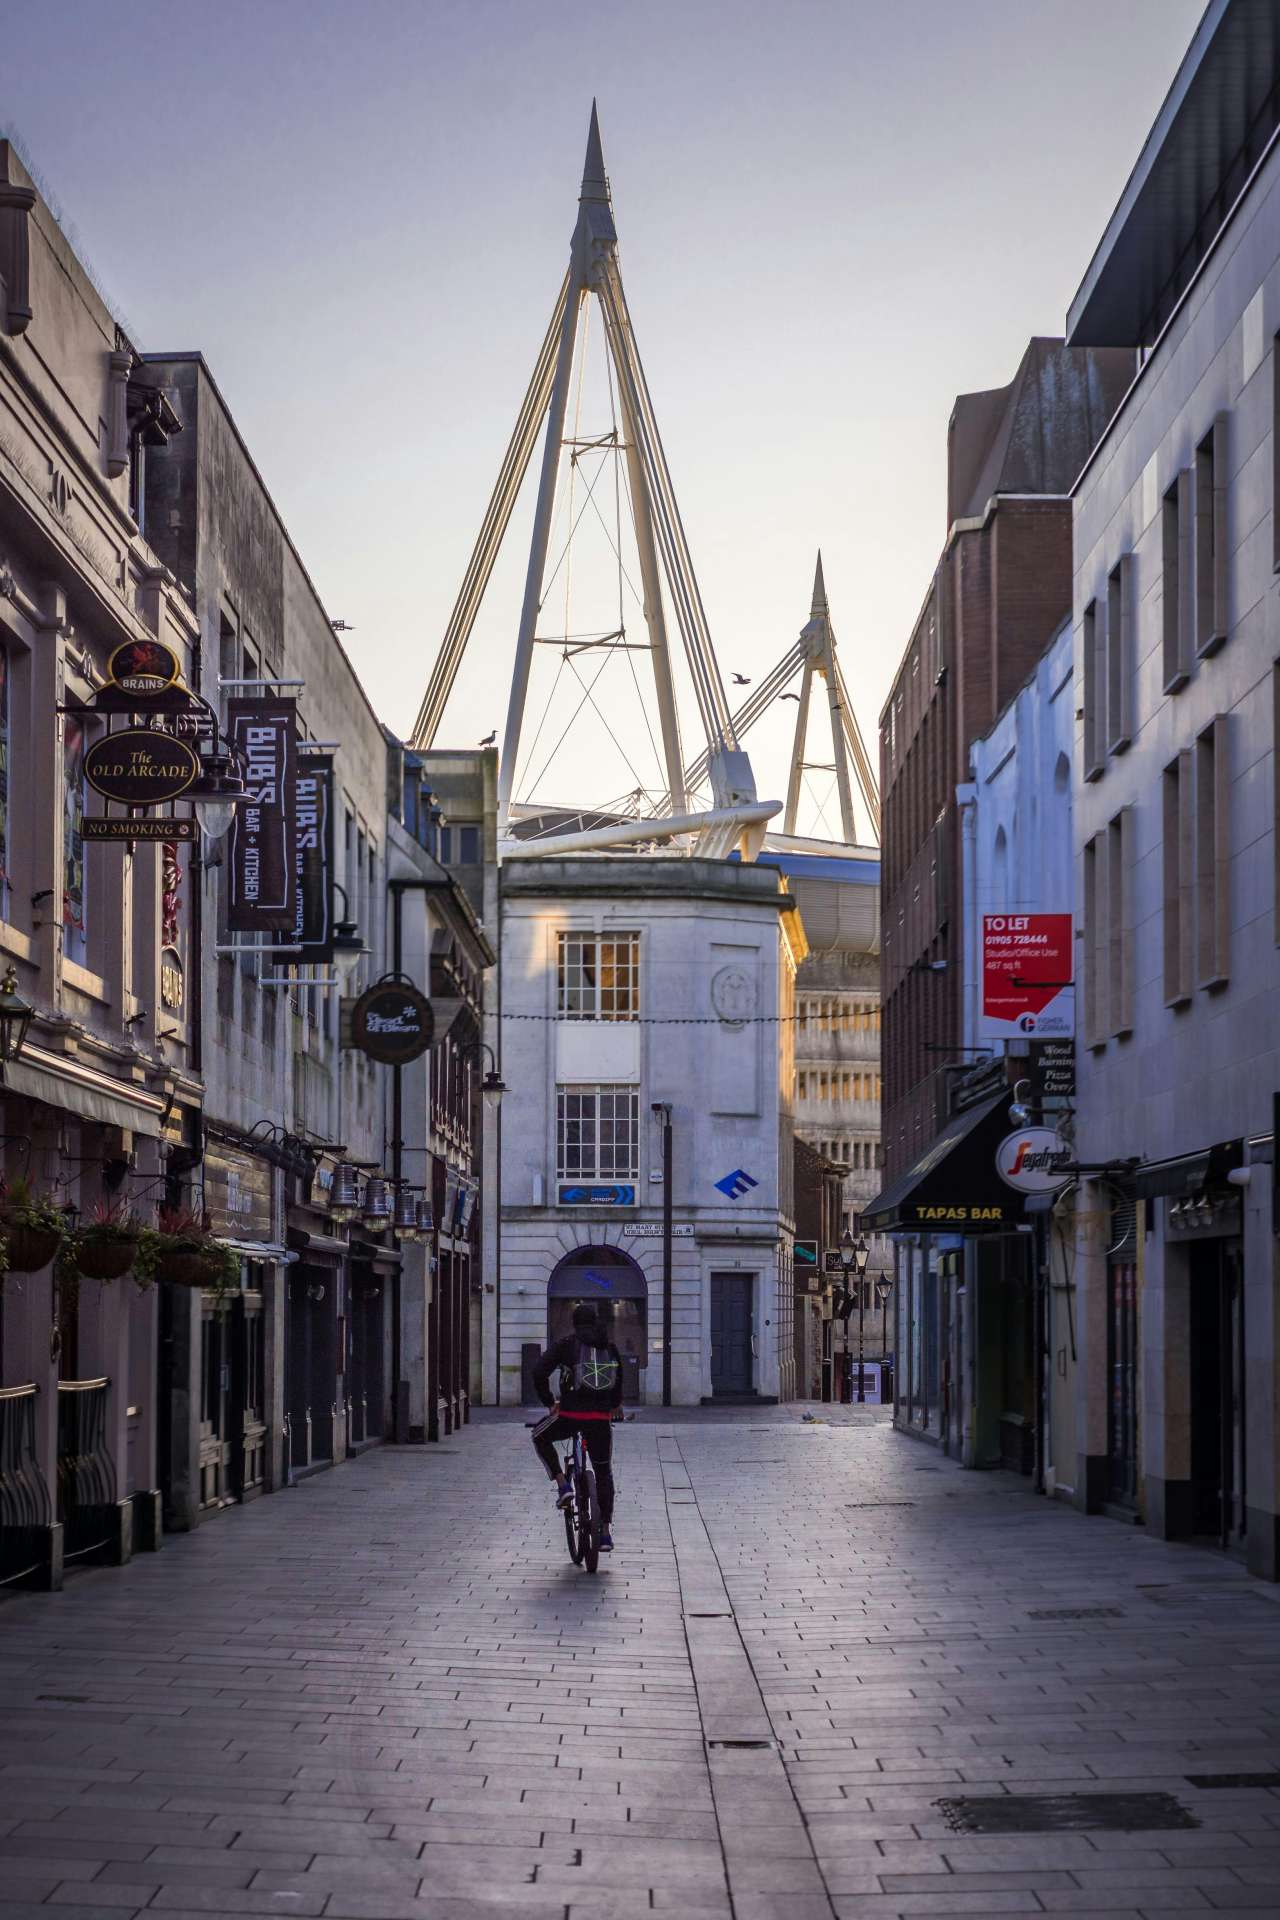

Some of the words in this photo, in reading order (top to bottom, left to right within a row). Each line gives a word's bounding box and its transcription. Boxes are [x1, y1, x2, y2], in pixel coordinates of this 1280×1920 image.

[122, 679, 164, 690] BRAINS
[130, 750, 153, 764] The
[93, 766, 124, 777] OLD
[127, 764, 190, 778] ARCADE
[244, 808, 260, 833] BAR
[88, 824, 107, 834] NO
[111, 823, 174, 835] SMOKING
[244, 848, 260, 901] KITCHEN
[985, 917, 1006, 931] TO
[1008, 917, 1030, 931] LET
[1044, 1044, 1072, 1055] Wood
[916, 1207, 967, 1219] TAPAS
[971, 1207, 1002, 1219] BAR
